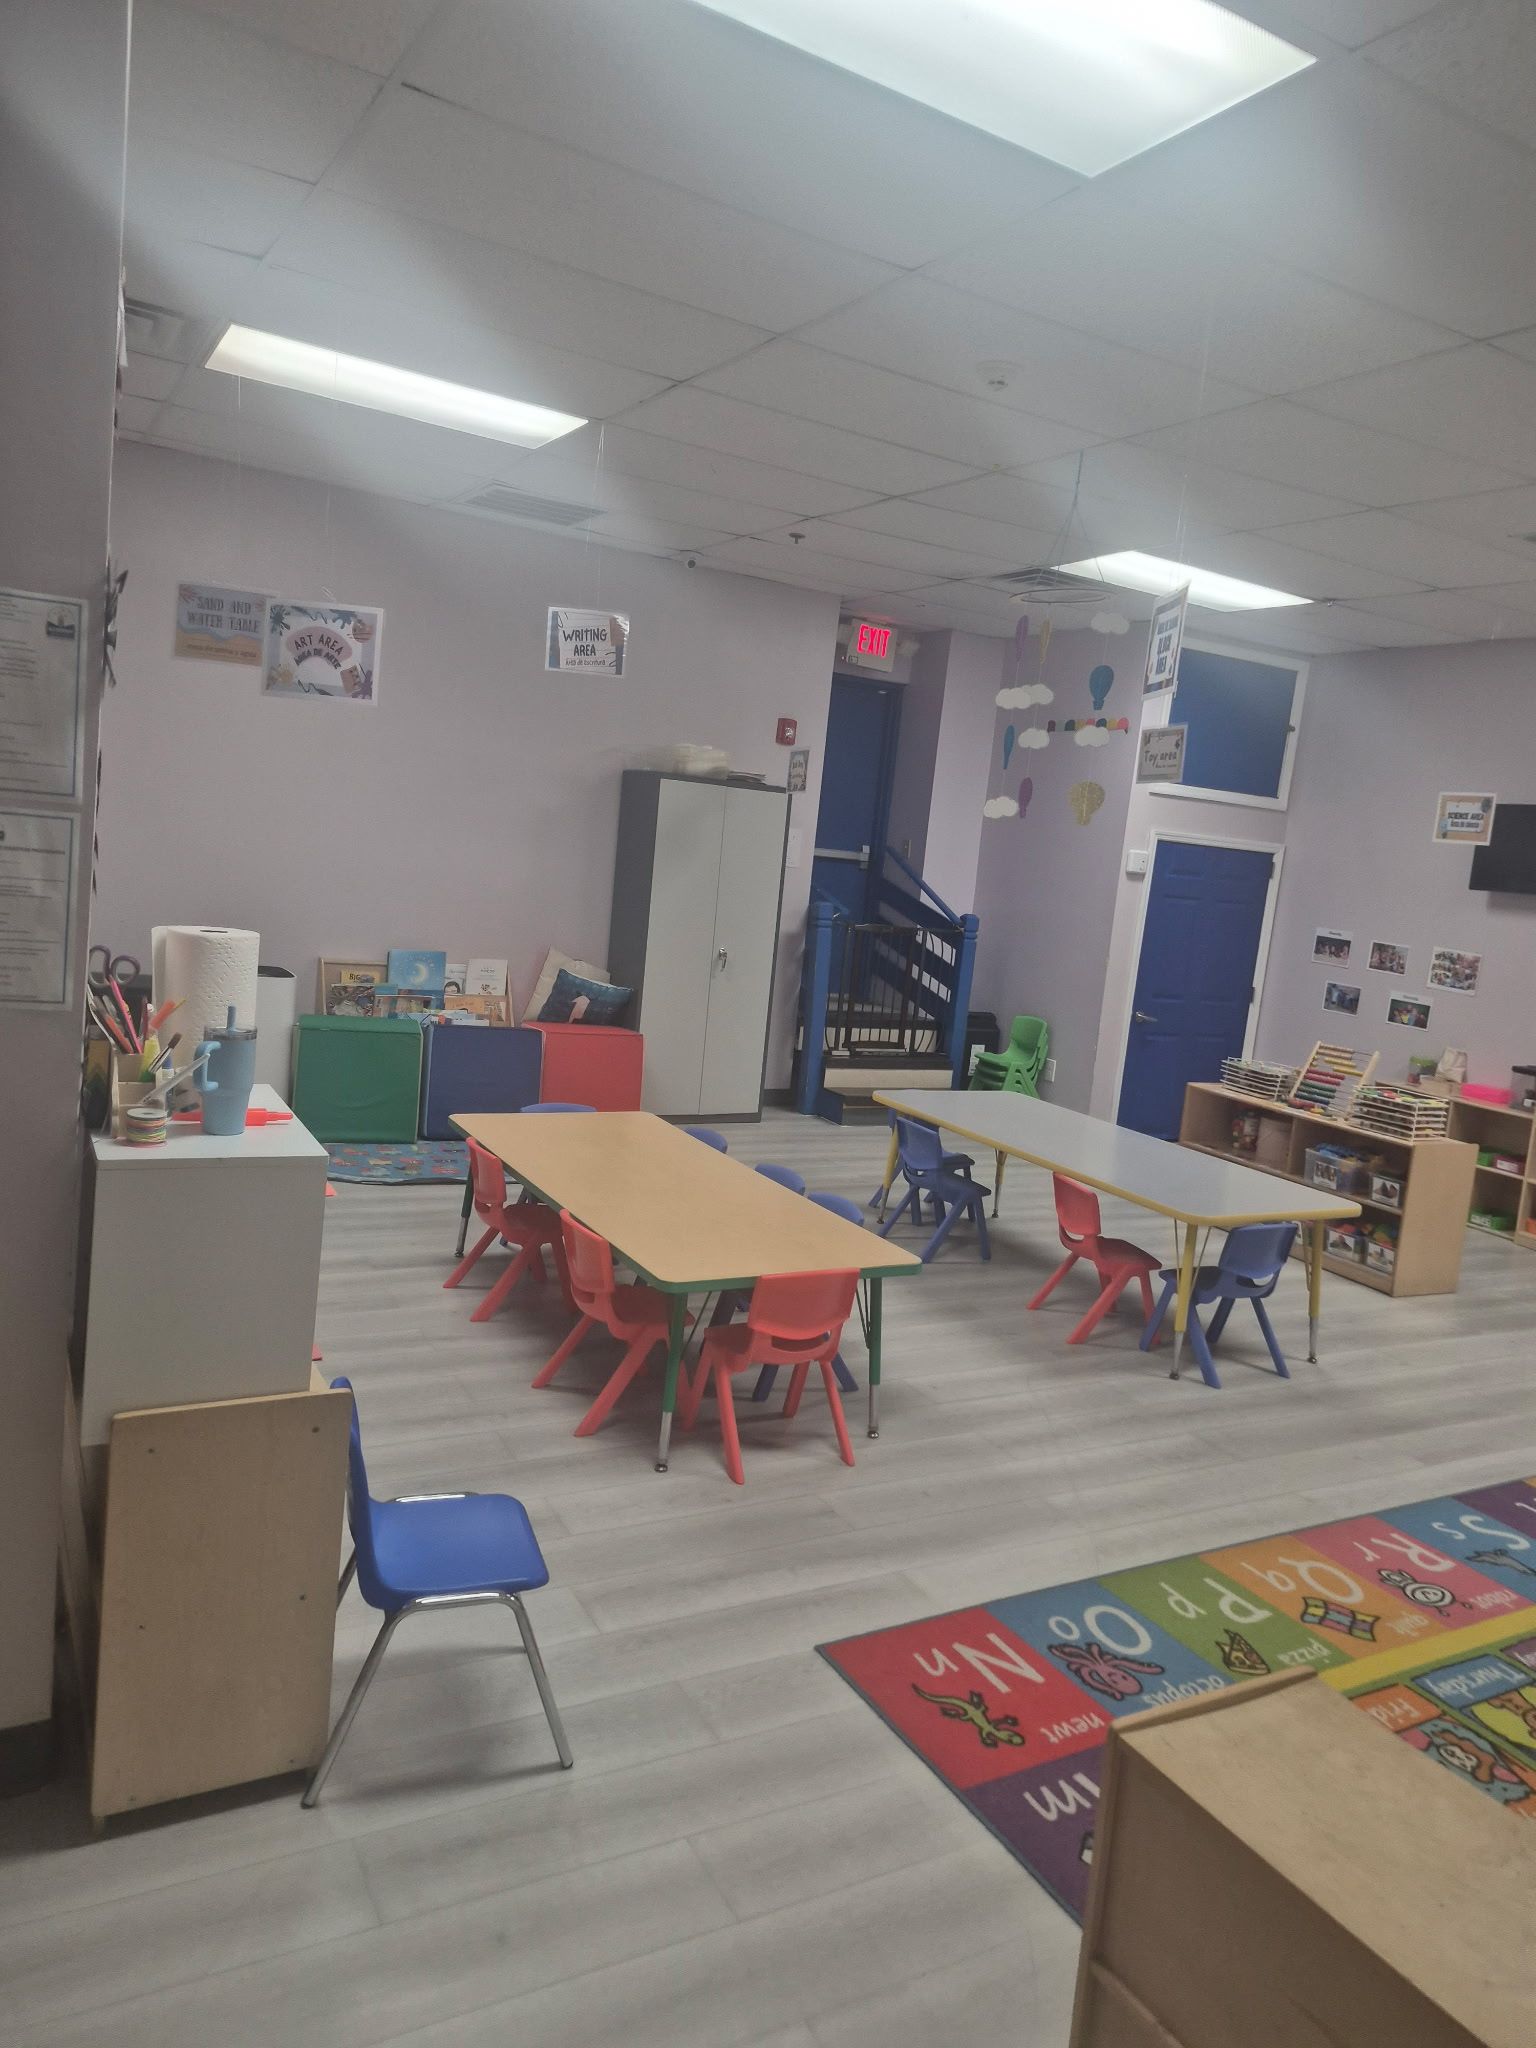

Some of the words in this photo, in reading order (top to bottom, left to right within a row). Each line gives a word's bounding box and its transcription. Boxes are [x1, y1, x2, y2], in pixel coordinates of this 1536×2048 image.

[294, 634, 313, 651] ART
[319, 634, 344, 656] AREA
[562, 627, 608, 642] WRITING
[573, 644, 597, 657] AREA
[857, 624, 890, 657] EXIT
[1276, 1636, 1333, 1665] pizza
[1142, 1673, 1225, 1706] octopus
[1423, 1662, 1529, 1699] Thursday
[1040, 1712, 1105, 1744] newt
[1365, 1698, 1422, 1731] Frid
